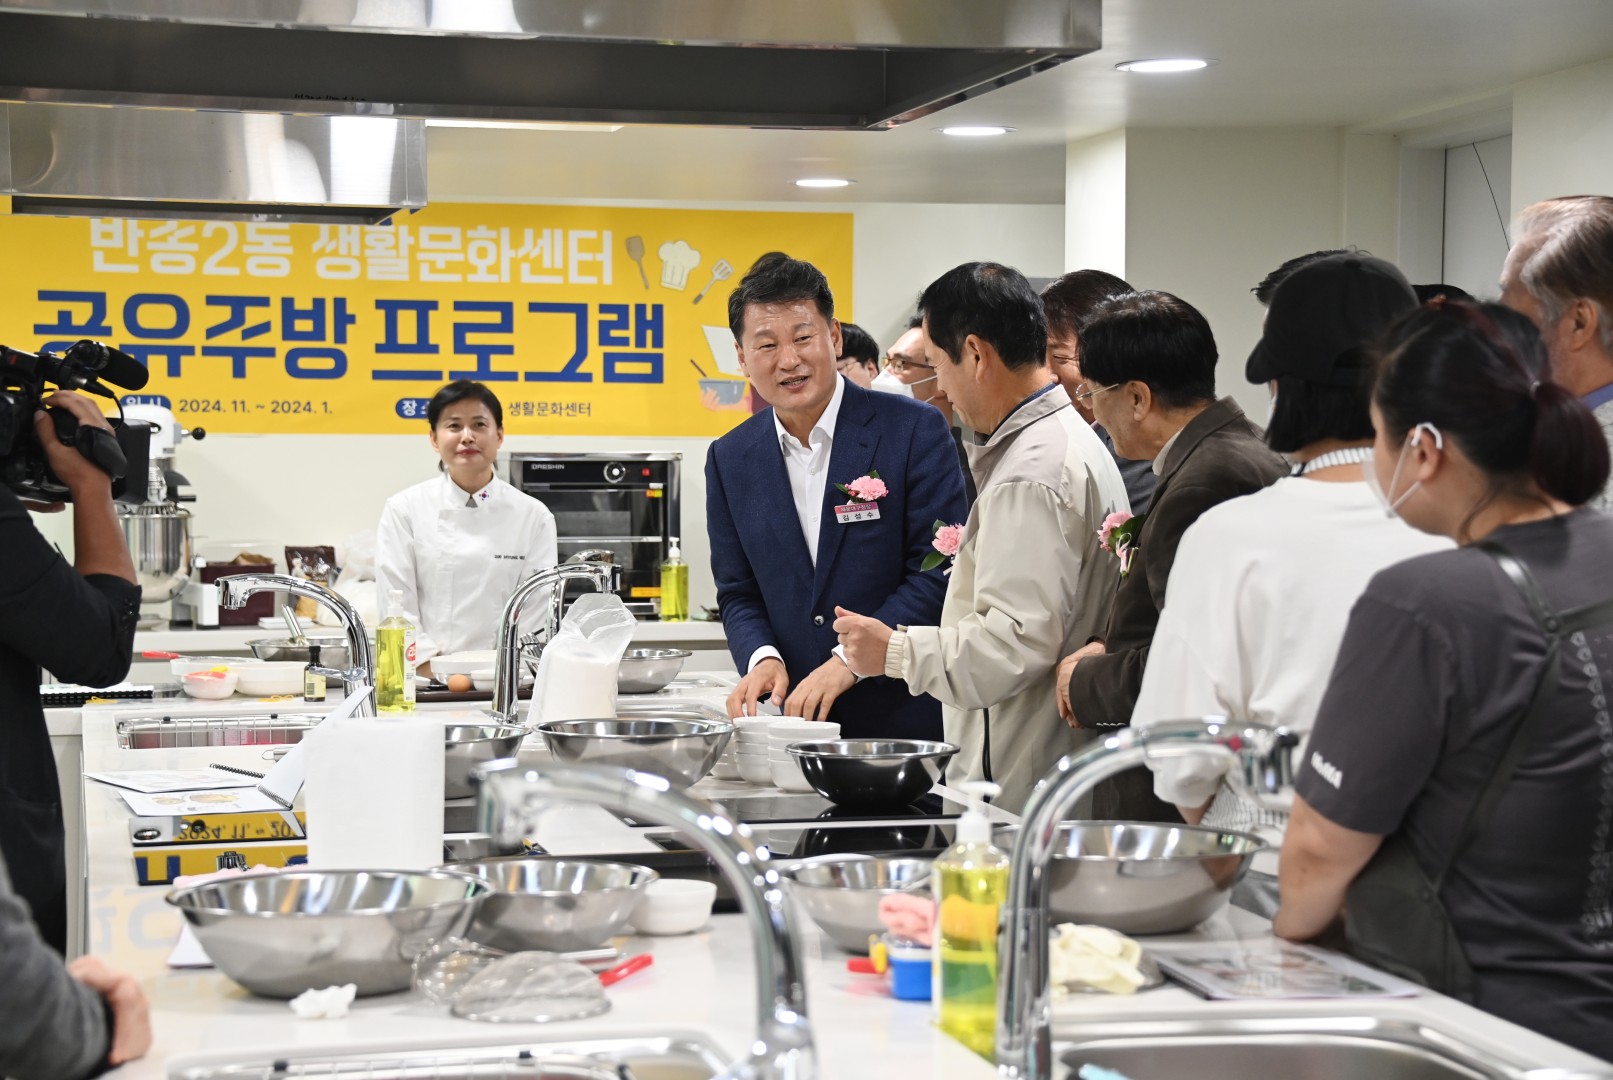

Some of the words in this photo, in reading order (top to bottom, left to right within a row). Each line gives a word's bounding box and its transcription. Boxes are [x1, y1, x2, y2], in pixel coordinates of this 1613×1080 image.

[90, 218, 293, 277] 반송2동
[312, 223, 612, 285] 생활문화센터
[33, 290, 356, 380] 공유주방
[372, 300, 664, 383] 프로그램
[179, 399, 226, 413] 2024.
[231, 399, 250, 413] 11.
[271, 401, 317, 414] 2024.
[322, 401, 333, 414] 1.
[509, 401, 591, 417] 생활문화센터
